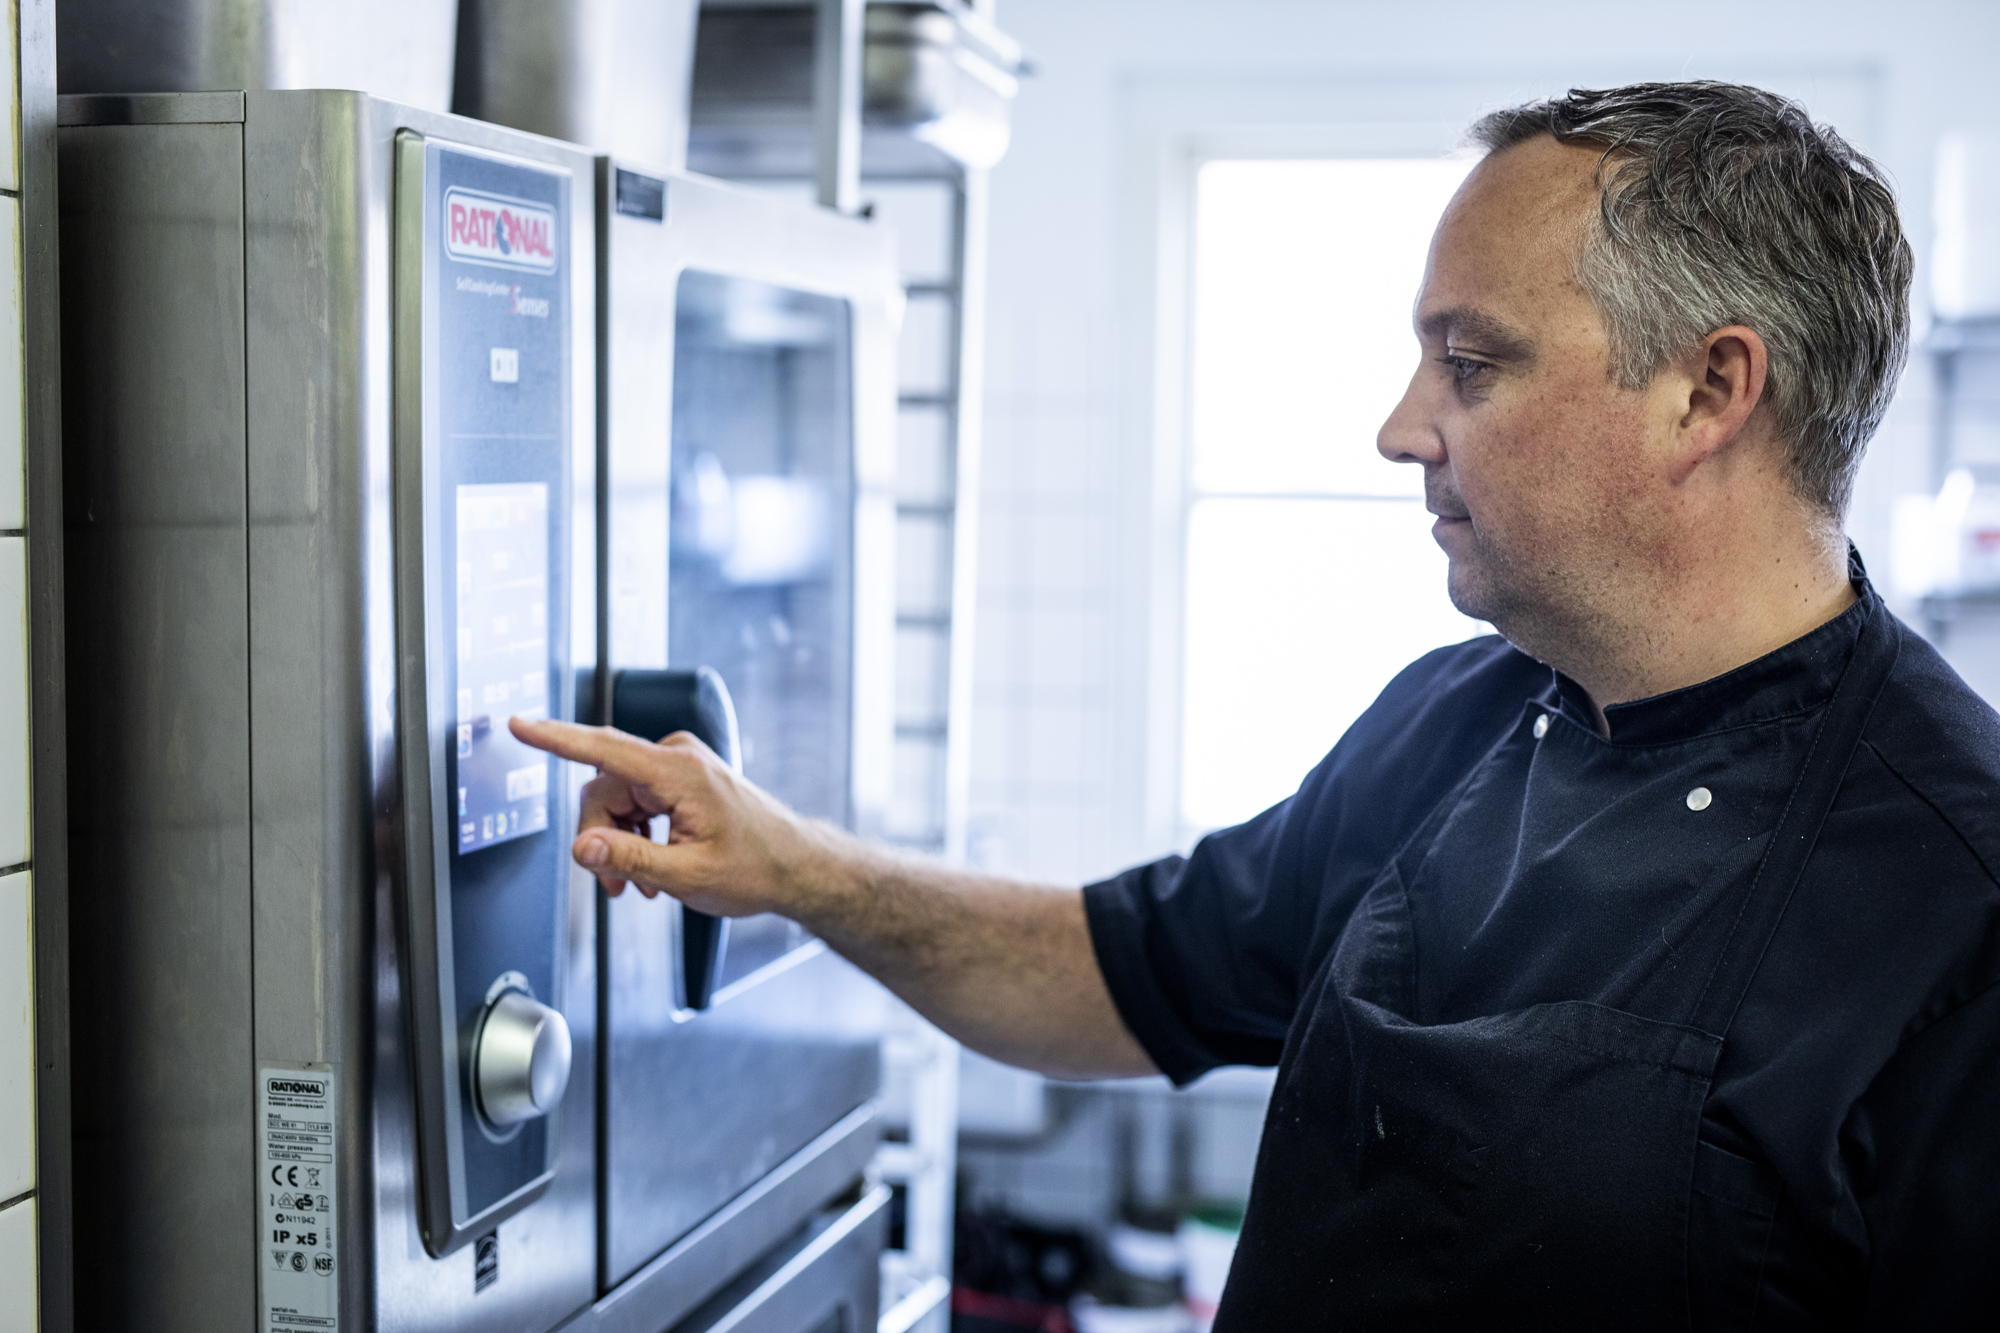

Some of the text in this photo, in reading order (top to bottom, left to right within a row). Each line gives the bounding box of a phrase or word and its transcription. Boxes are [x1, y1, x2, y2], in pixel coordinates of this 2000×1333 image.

[451, 203, 552, 257] RATIONAL
[271, 1081, 321, 1094] RATIONAL
[286, 1215, 316, 1225] N11942
[273, 1230, 317, 1246] IP x5
[315, 1257, 332, 1271] NSF
